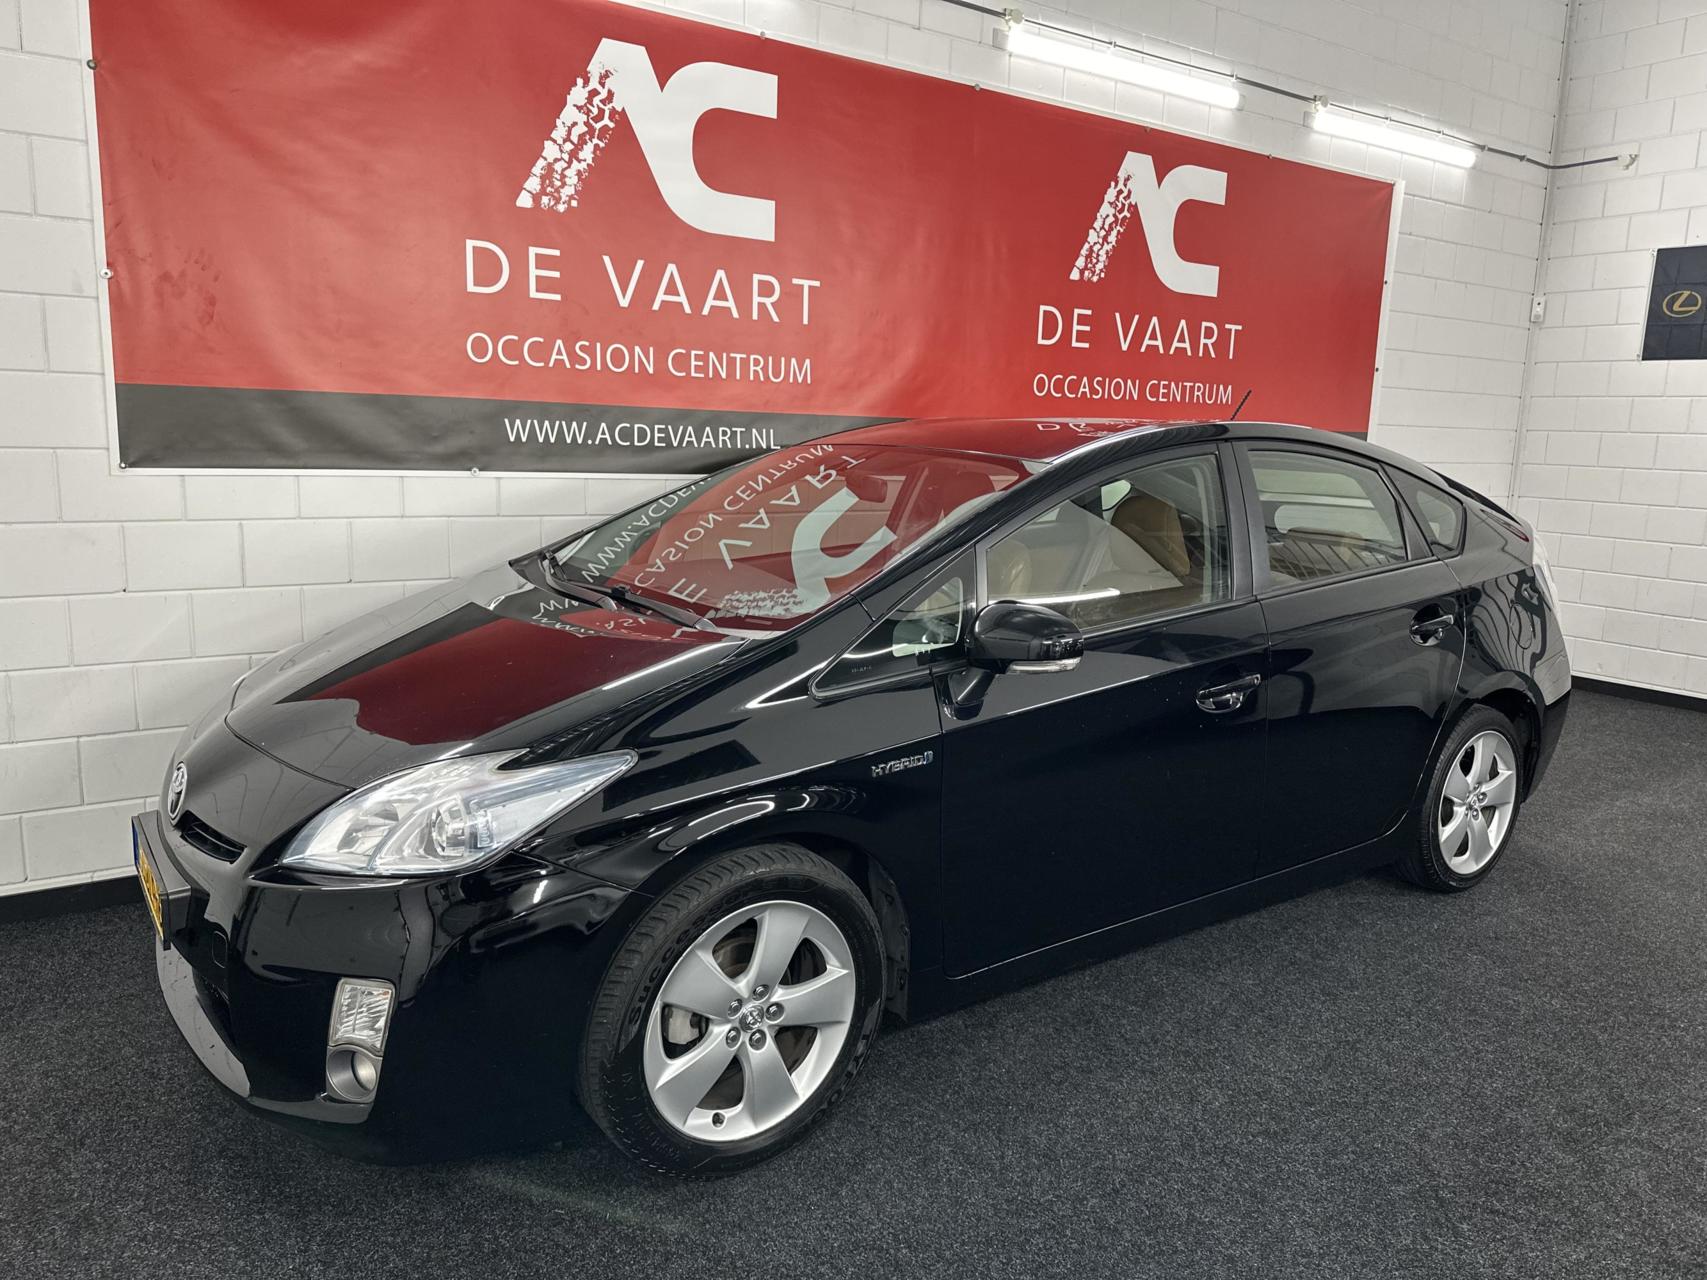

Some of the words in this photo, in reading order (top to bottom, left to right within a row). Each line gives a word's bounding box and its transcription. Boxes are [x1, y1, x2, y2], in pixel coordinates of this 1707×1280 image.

[516, 37, 779, 242] AC
[1069, 150, 1228, 298] AC
[465, 238, 562, 301] DE
[602, 255, 821, 325] VAART
[466, 332, 655, 374] OCCASION
[667, 348, 812, 384] CENTRUM
[1037, 304, 1092, 349] DE
[1114, 312, 1243, 360] VAART
[1033, 373, 1139, 401] OCCASION
[1146, 379, 1232, 405] CENTRUM
[504, 418, 781, 450] WWW.ACDEVAART.NL
[870, 754, 924, 778] HYBRID
